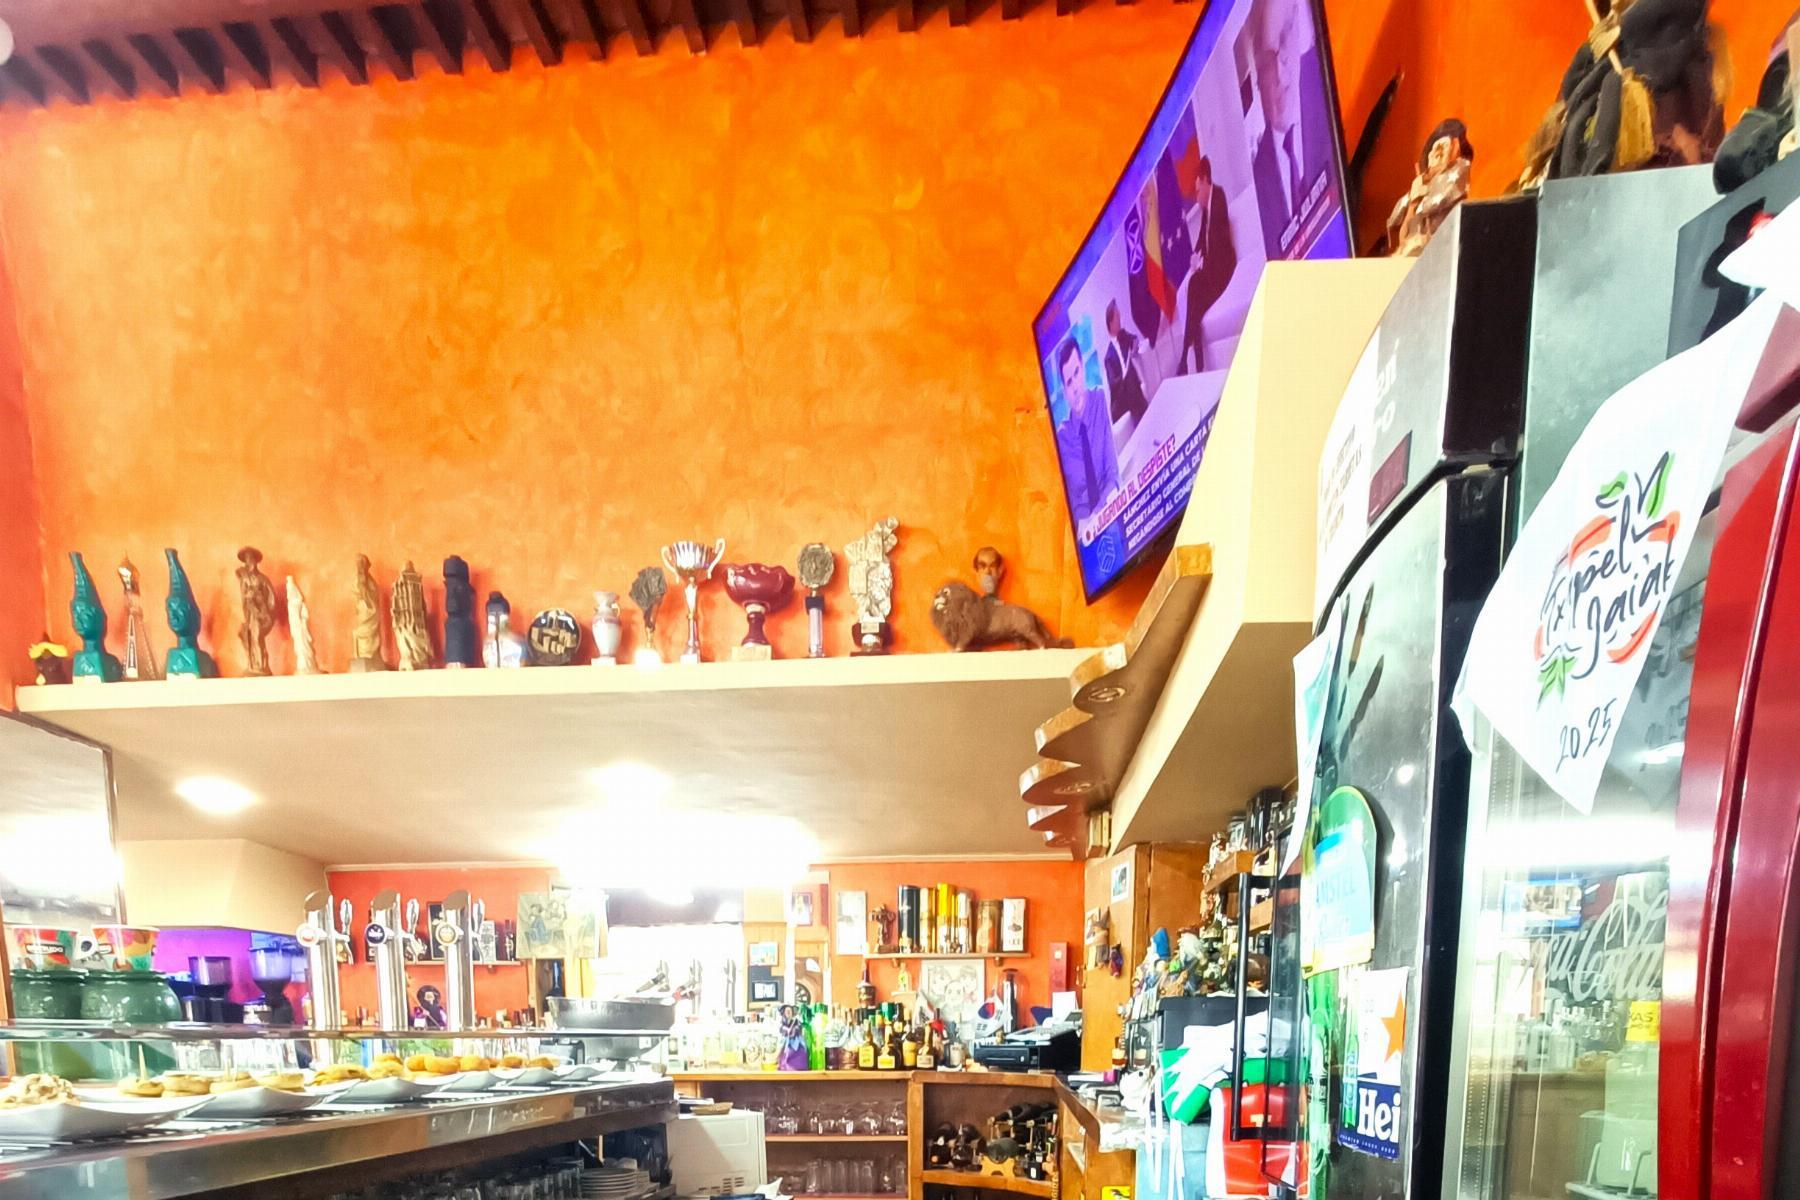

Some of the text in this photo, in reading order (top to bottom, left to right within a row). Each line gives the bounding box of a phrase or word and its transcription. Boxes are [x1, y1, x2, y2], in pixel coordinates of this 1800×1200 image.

[1137, 432, 1177, 489] DESPISTE?
[1184, 425, 1208, 456] CARTA
[1125, 495, 1162, 538] SECRETARIO
[1162, 466, 1191, 498] GENERAL
[1556, 698, 1617, 773] 2025
